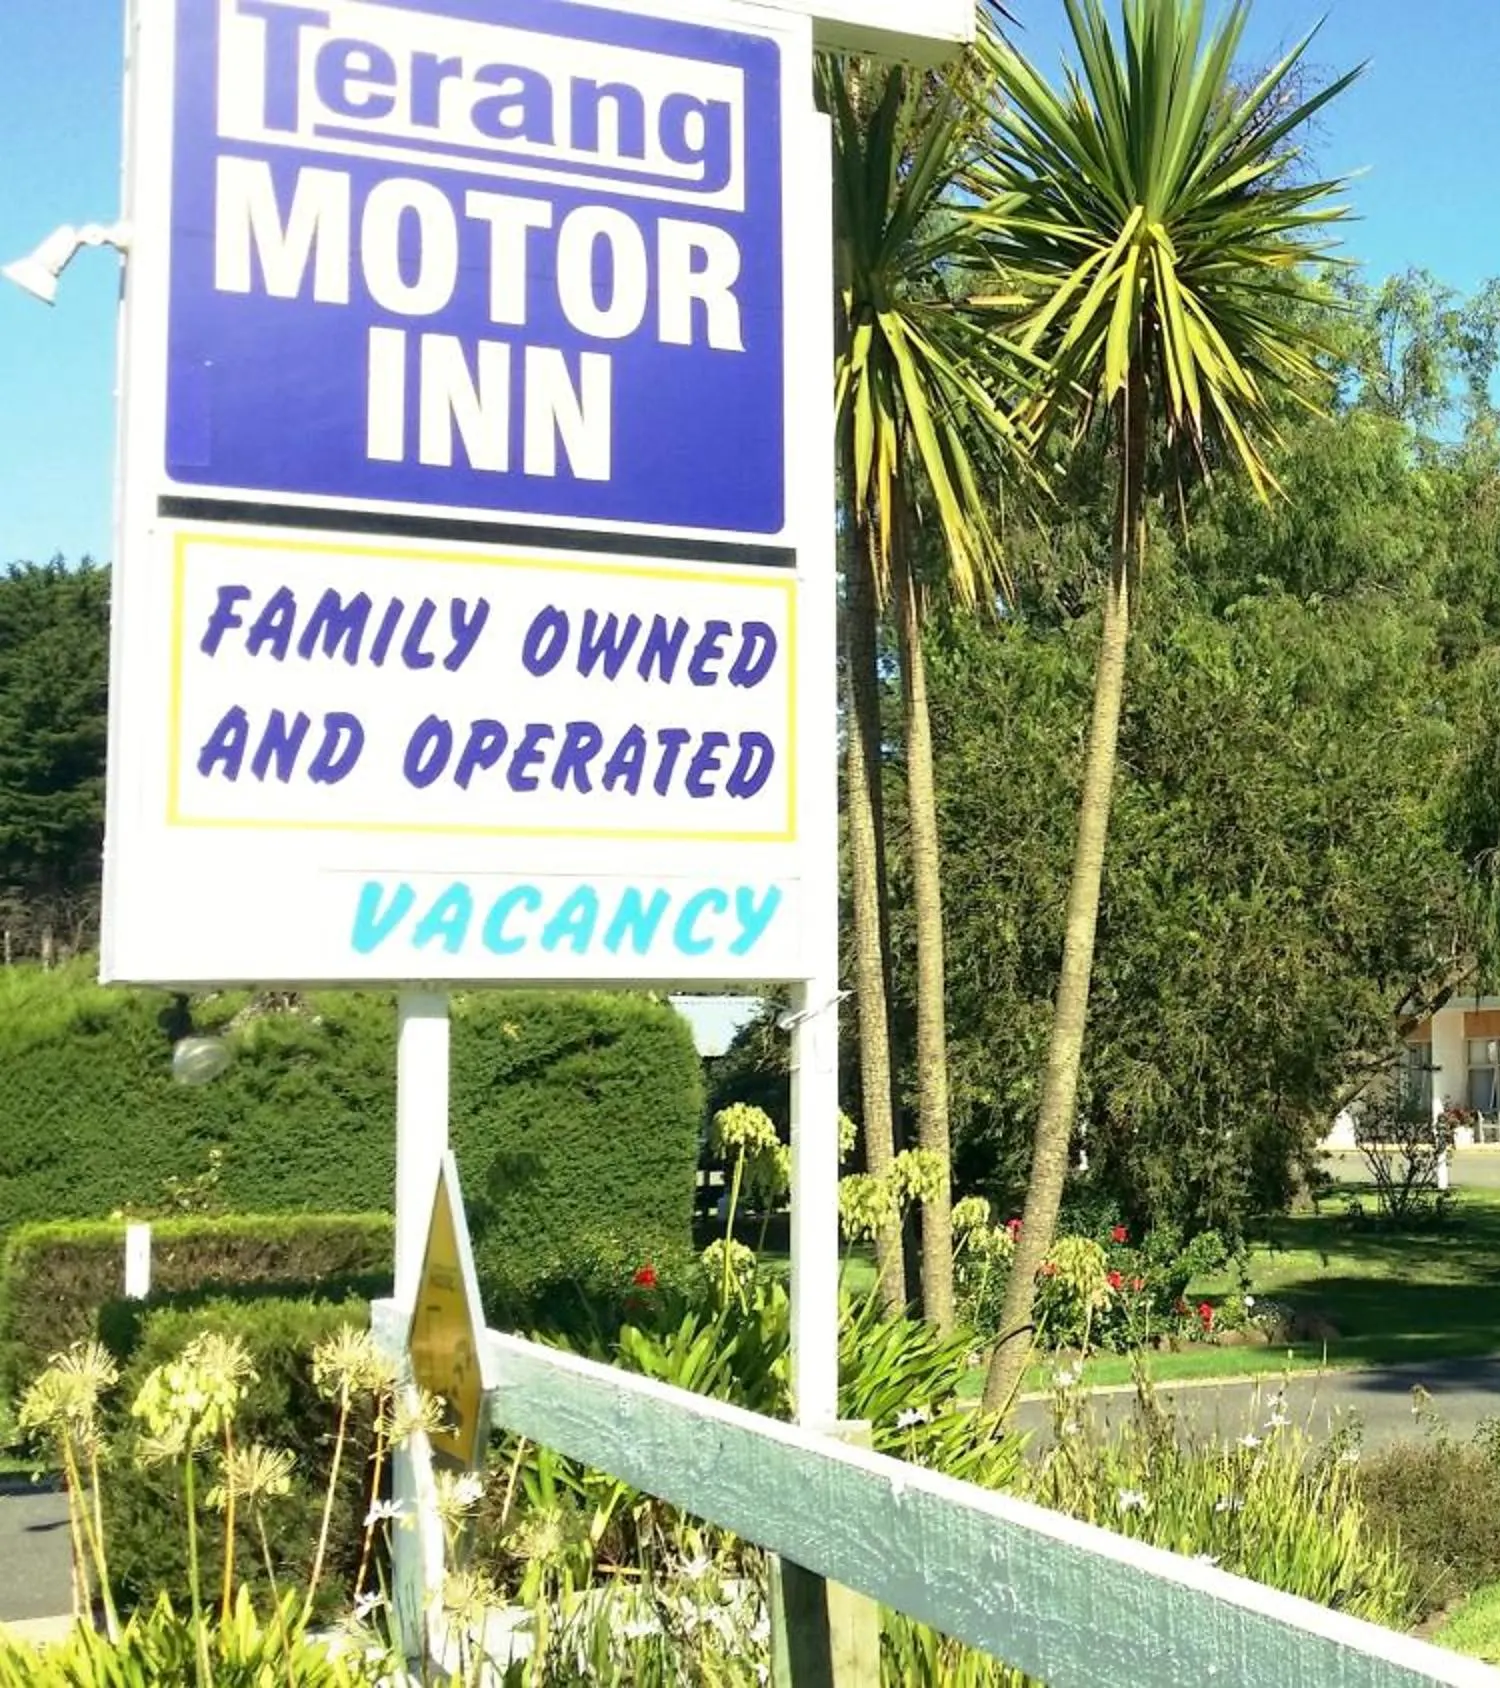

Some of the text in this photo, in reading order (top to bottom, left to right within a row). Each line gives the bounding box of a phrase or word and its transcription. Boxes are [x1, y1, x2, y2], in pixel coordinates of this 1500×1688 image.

[235, 0, 733, 194] Terang
[214, 153, 747, 353] MOTOR
[365, 326, 613, 482] INN
[199, 584, 779, 689] FAMILY OWNED
[197, 704, 777, 799] AND OPERATED
[348, 880, 783, 957] VACANCY
